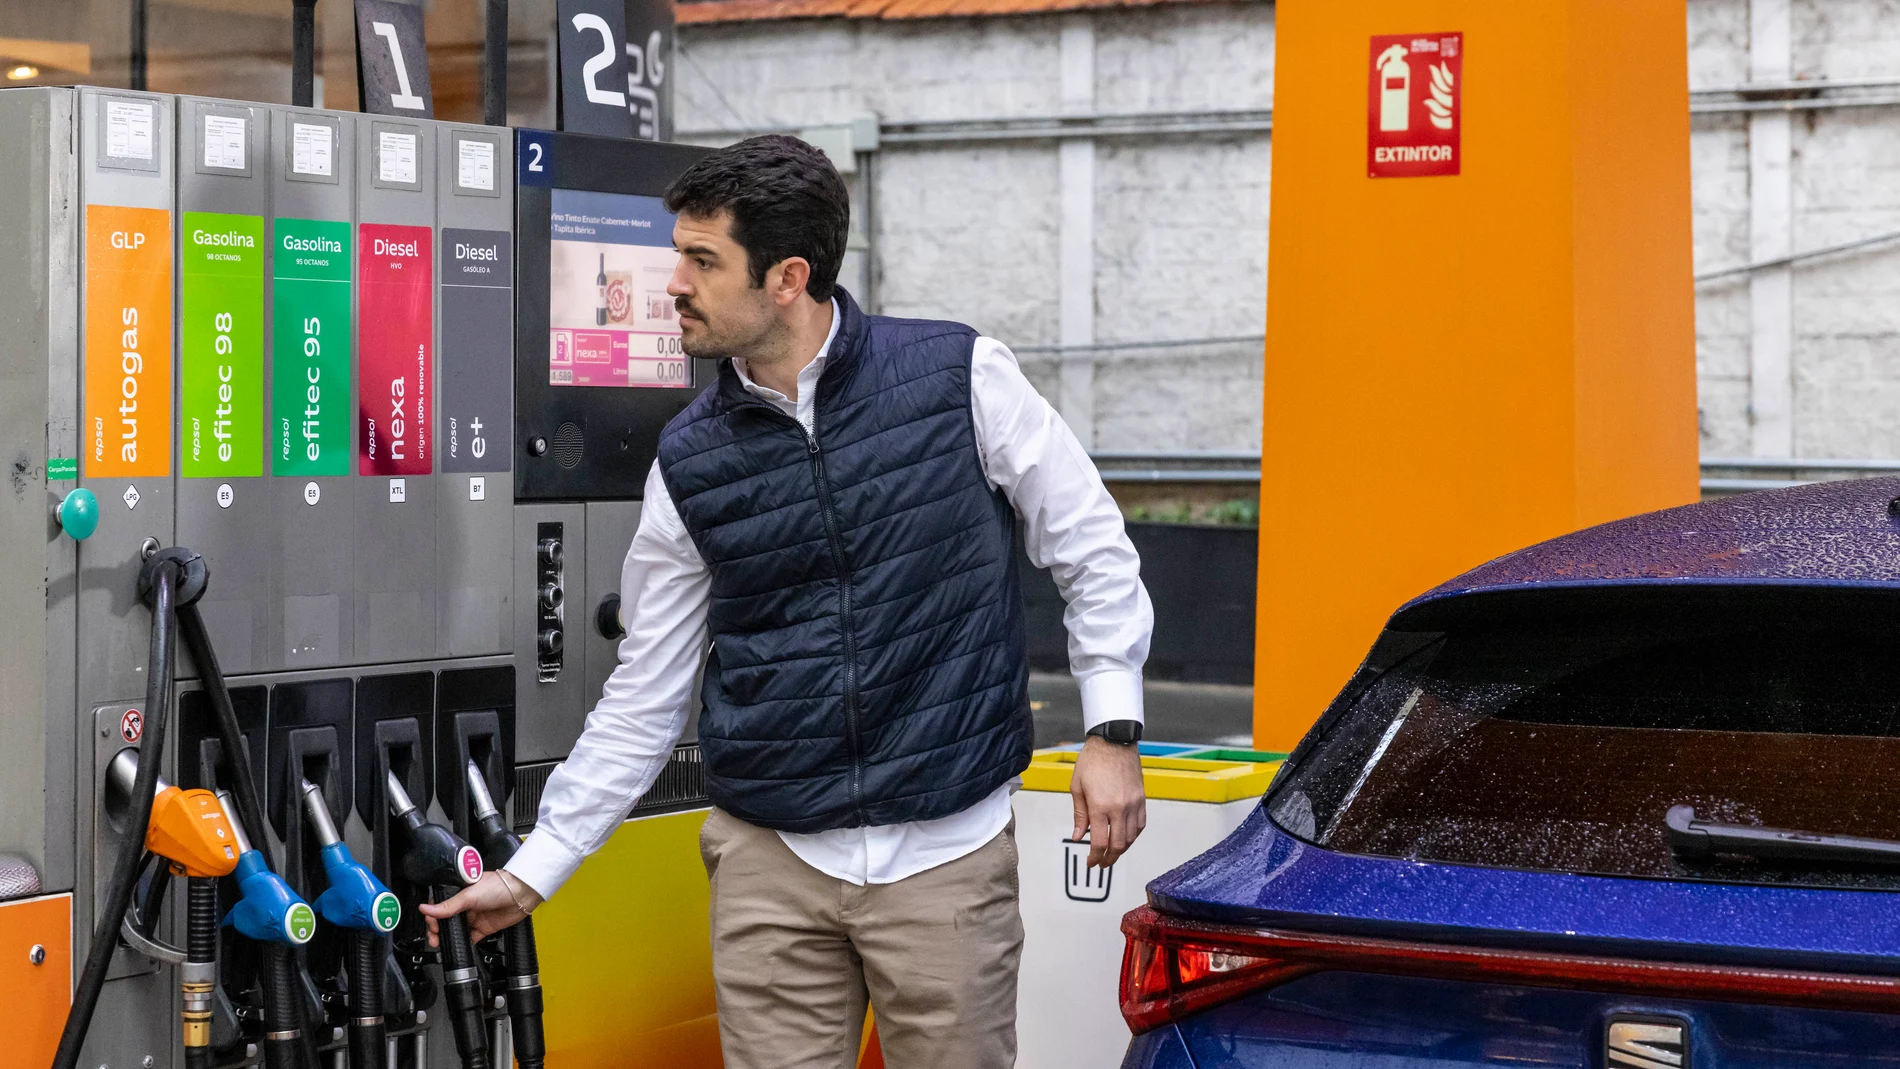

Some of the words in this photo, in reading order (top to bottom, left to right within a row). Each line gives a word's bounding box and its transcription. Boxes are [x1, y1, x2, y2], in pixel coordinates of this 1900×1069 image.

[373, 22, 425, 110] 1
[571, 13, 627, 107] 2
[528, 142, 544, 172] 2
[1375, 145, 1452, 163] EXTINTOR
[565, 214, 581, 222] Tinto
[554, 224, 574, 234] Tapita
[574, 226, 596, 235] Ibérica
[111, 231, 145, 249] GLP
[193, 230, 255, 248] Gasolina
[283, 235, 342, 253] Gasolina
[374, 239, 419, 257] Diesel
[206, 253, 214, 261] 98
[215, 254, 241, 262] OCTANOS
[455, 243, 498, 261] Diesel
[304, 259, 329, 267] OCTANOS
[463, 265, 485, 273] GASÓLEO
[215, 312, 232, 355] 98
[304, 317, 321, 357] 95
[558, 345, 563, 354] 2
[576, 348, 597, 359] nexa
[613, 341, 628, 349] Euros
[613, 367, 627, 375] Litros
[656, 362, 683, 382] 0,00
[119, 307, 142, 463] autogas
[213, 365, 232, 462] efitec
[303, 367, 320, 461] efitec
[390, 376, 405, 460] nexa
[95, 417, 104, 462] repsol
[192, 417, 201, 461] repsol
[282, 417, 290, 460] repsol
[470, 416, 486, 459] e+
[126, 493, 137, 501] LPG
[221, 492, 229, 500] E5
[392, 487, 403, 495] XTL
